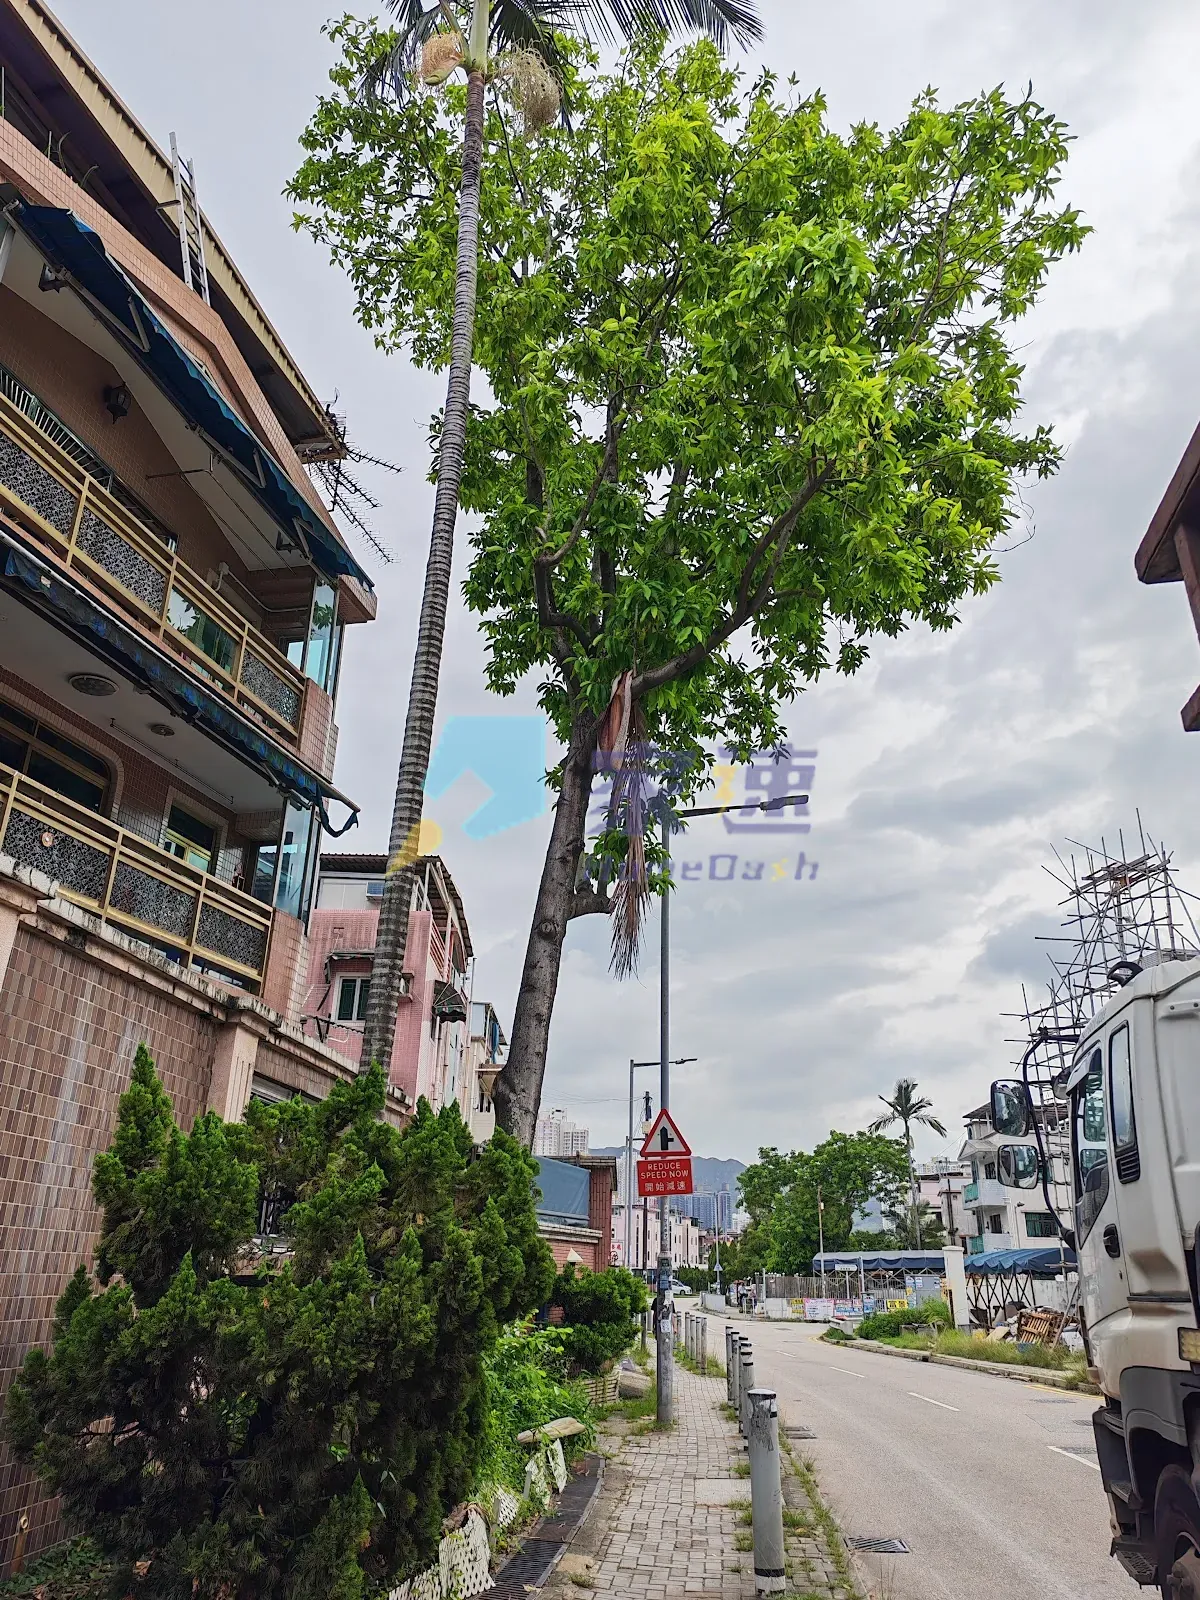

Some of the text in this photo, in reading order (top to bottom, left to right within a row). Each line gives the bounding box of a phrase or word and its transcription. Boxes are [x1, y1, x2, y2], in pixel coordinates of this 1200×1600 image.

[647, 1162, 681, 1170] REDUCE
[640, 1170, 689, 1179] SPEED NOW
[644, 1180, 686, 1192] 開始減速
